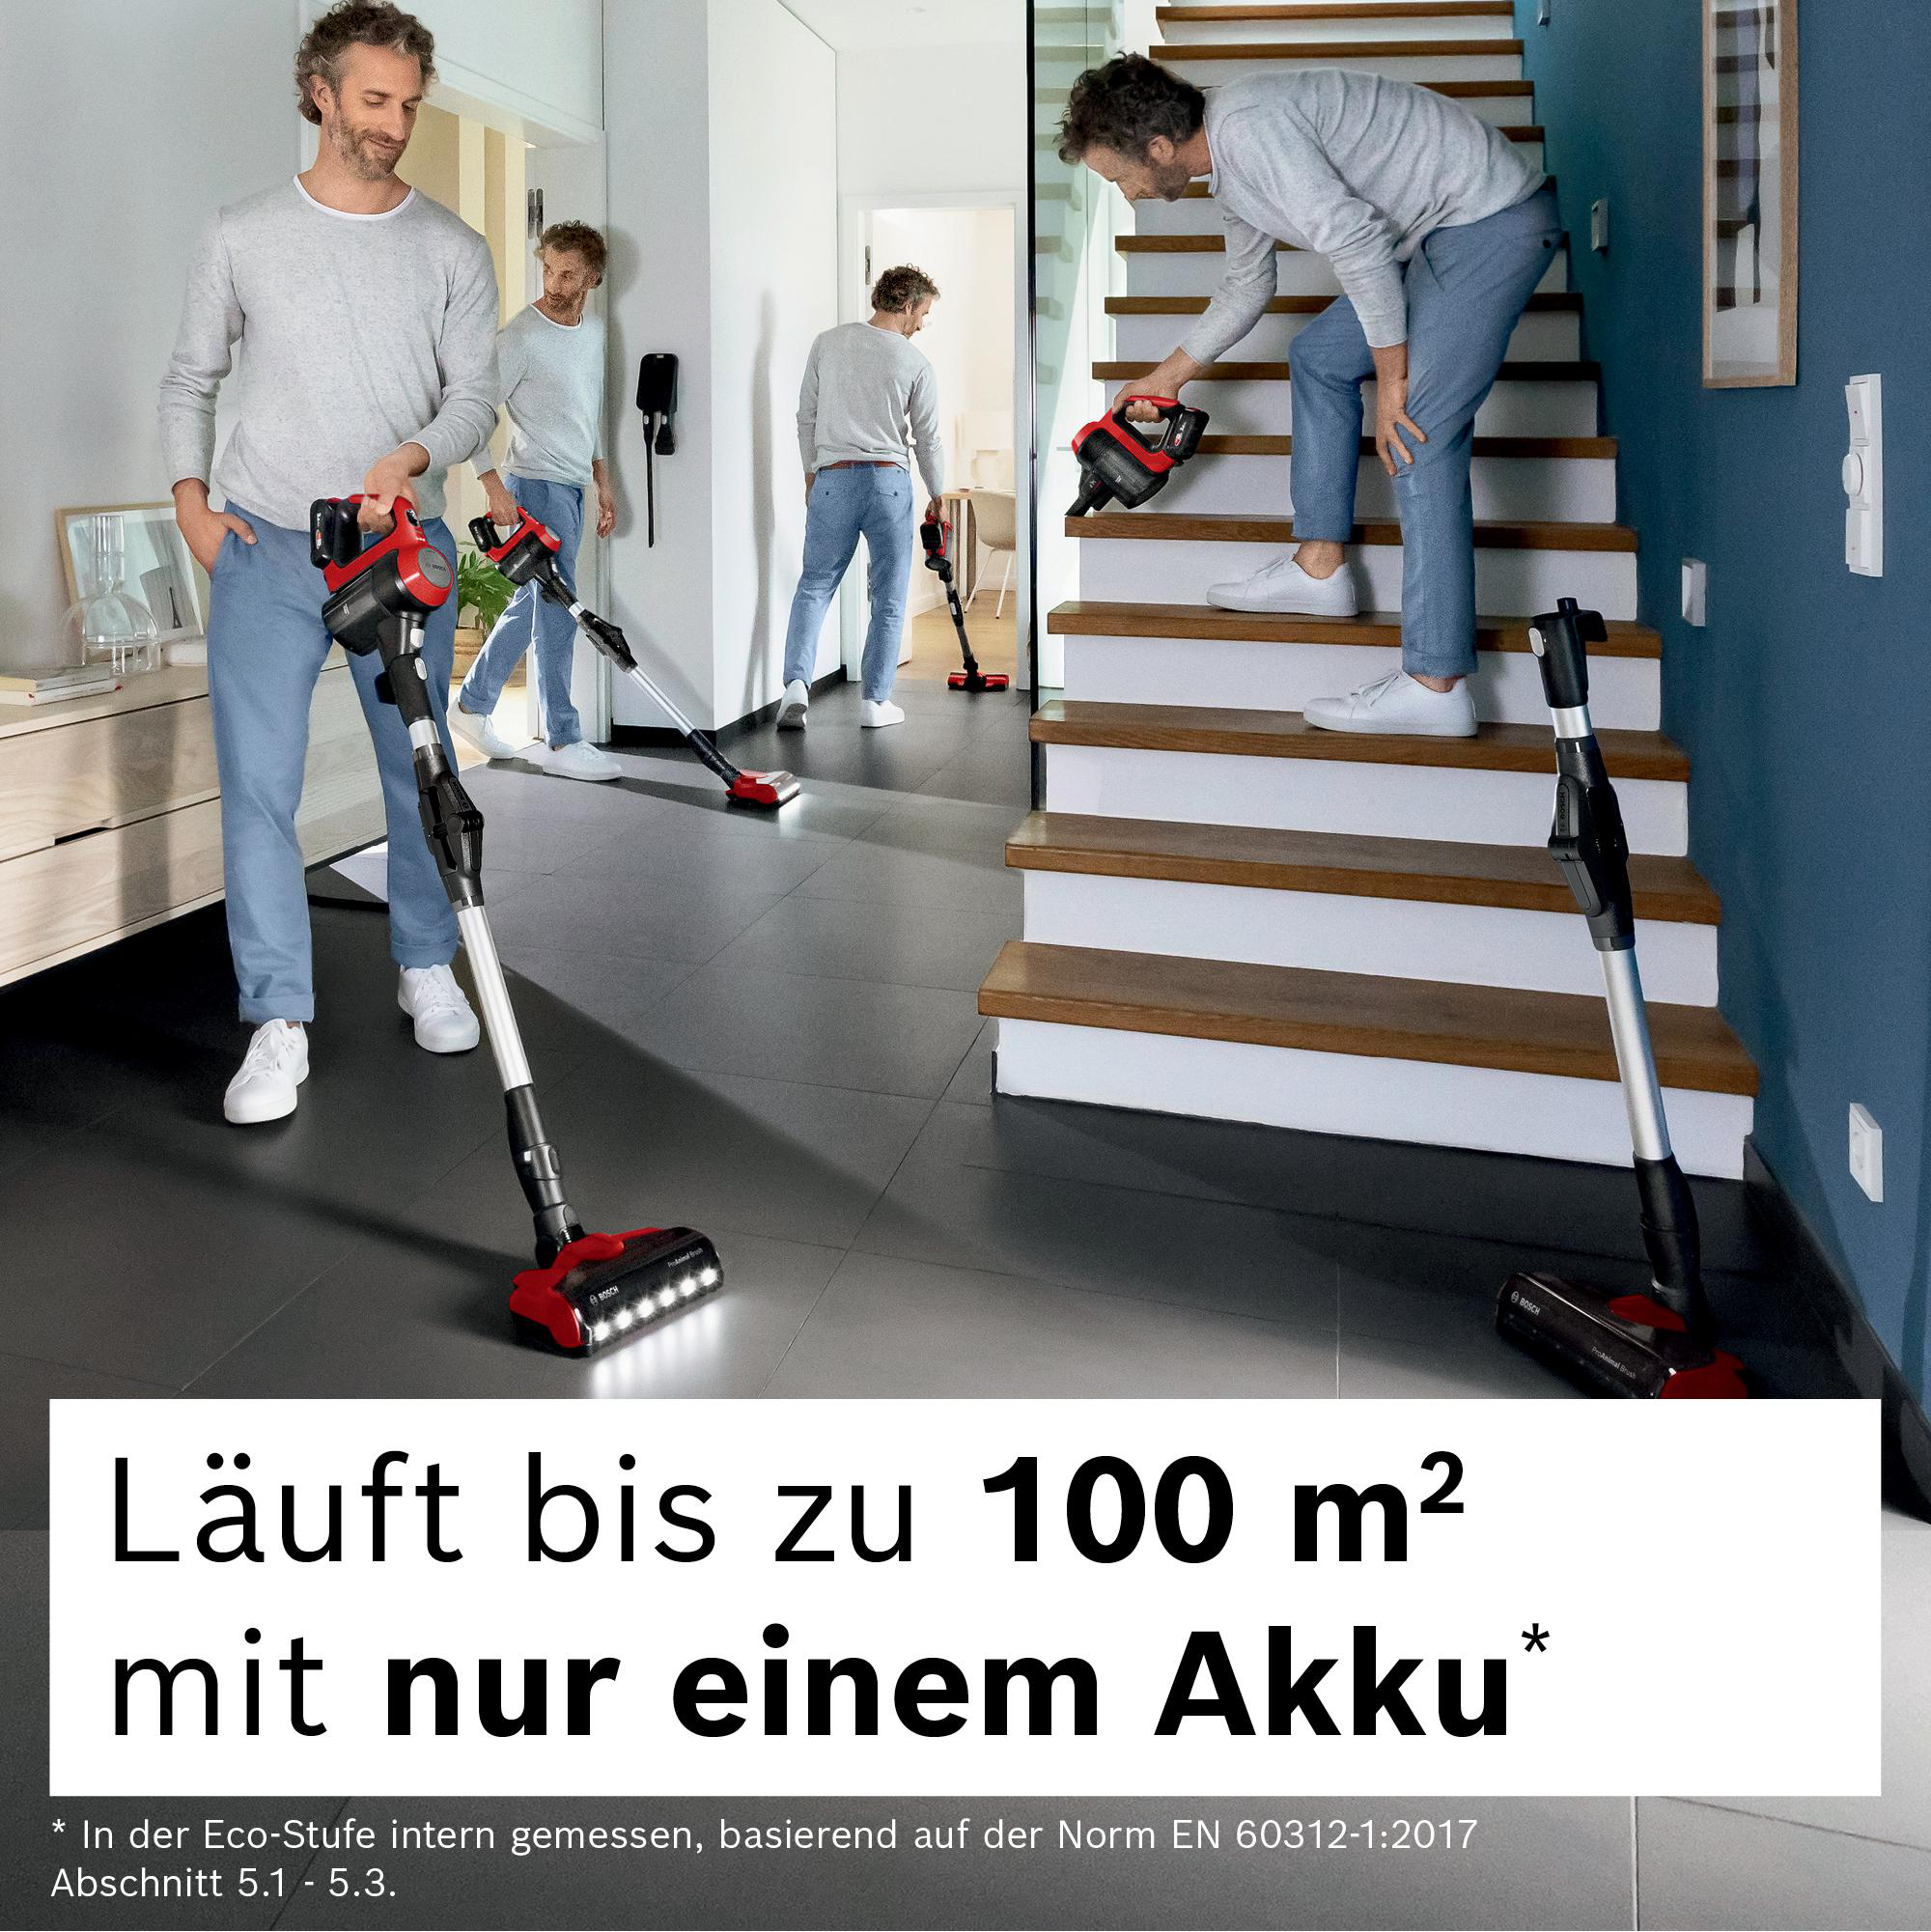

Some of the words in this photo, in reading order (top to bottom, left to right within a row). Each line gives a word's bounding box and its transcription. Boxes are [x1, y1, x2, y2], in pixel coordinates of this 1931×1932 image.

[598, 1285, 620, 1302] BOSCH
[1519, 1297, 1541, 1317] BOSCH
[1591, 1345, 1620, 1369] ProAnimal
[1619, 1363, 1637, 1381] Brush
